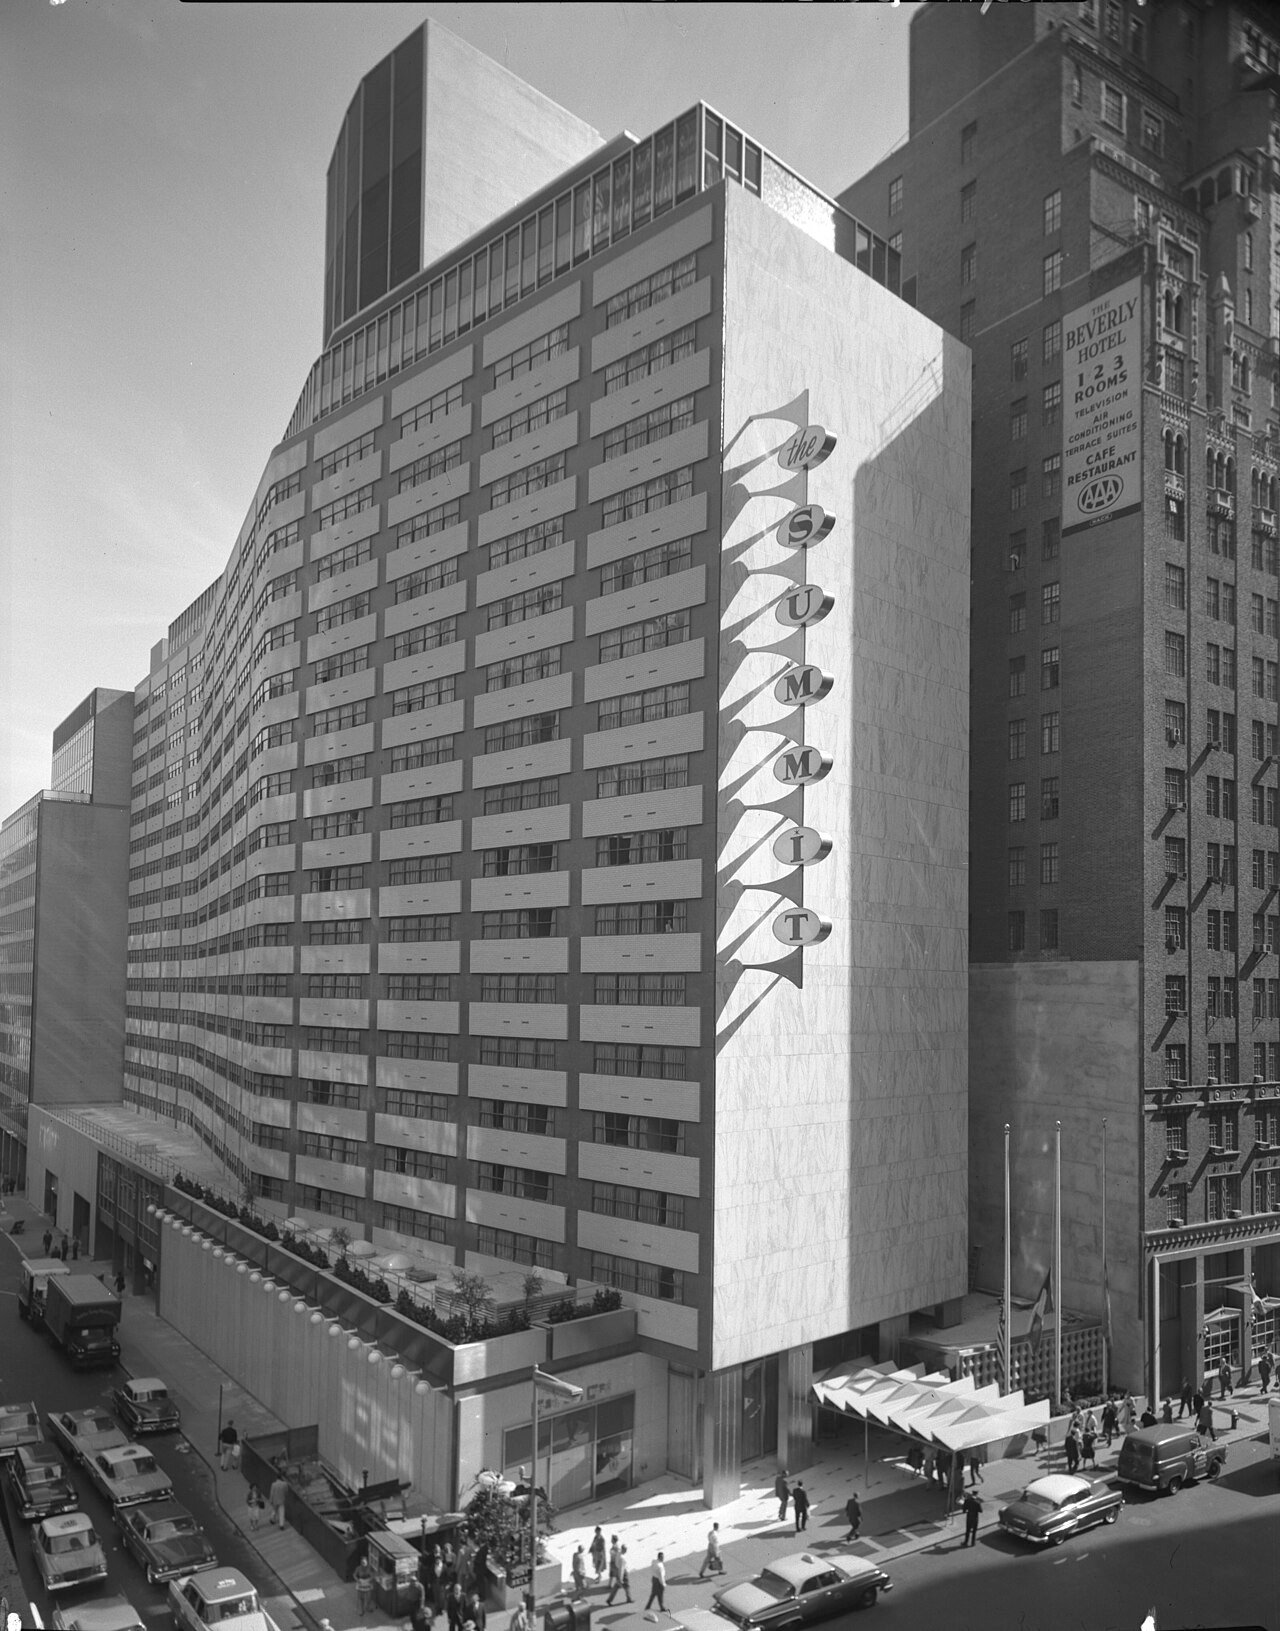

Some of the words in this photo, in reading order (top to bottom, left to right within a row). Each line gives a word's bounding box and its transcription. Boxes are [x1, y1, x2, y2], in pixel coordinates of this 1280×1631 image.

[1066, 297, 1138, 351] BEVERLY
[1092, 301, 1111, 315] THE
[1078, 329, 1127, 364] HOTEL
[1075, 369, 1128, 404] ROOMS
[1078, 373, 1084, 387] 1
[1094, 364, 1104, 380] 2
[1114, 355, 1124, 371] 3
[1075, 389, 1128, 419] TELEVISION
[1093, 411, 1109, 425] AIR
[1065, 436, 1102, 457] TERRACE
[1107, 421, 1138, 441] SUITES
[1068, 410, 1133, 444] CONDITIONING
[787, 430, 818, 467] the
[1086, 445, 1116, 465] CAFE
[1067, 450, 1137, 486] RESTAURANT
[1082, 479, 1119, 509] AAA
[783, 507, 813, 942] SUMMIT
